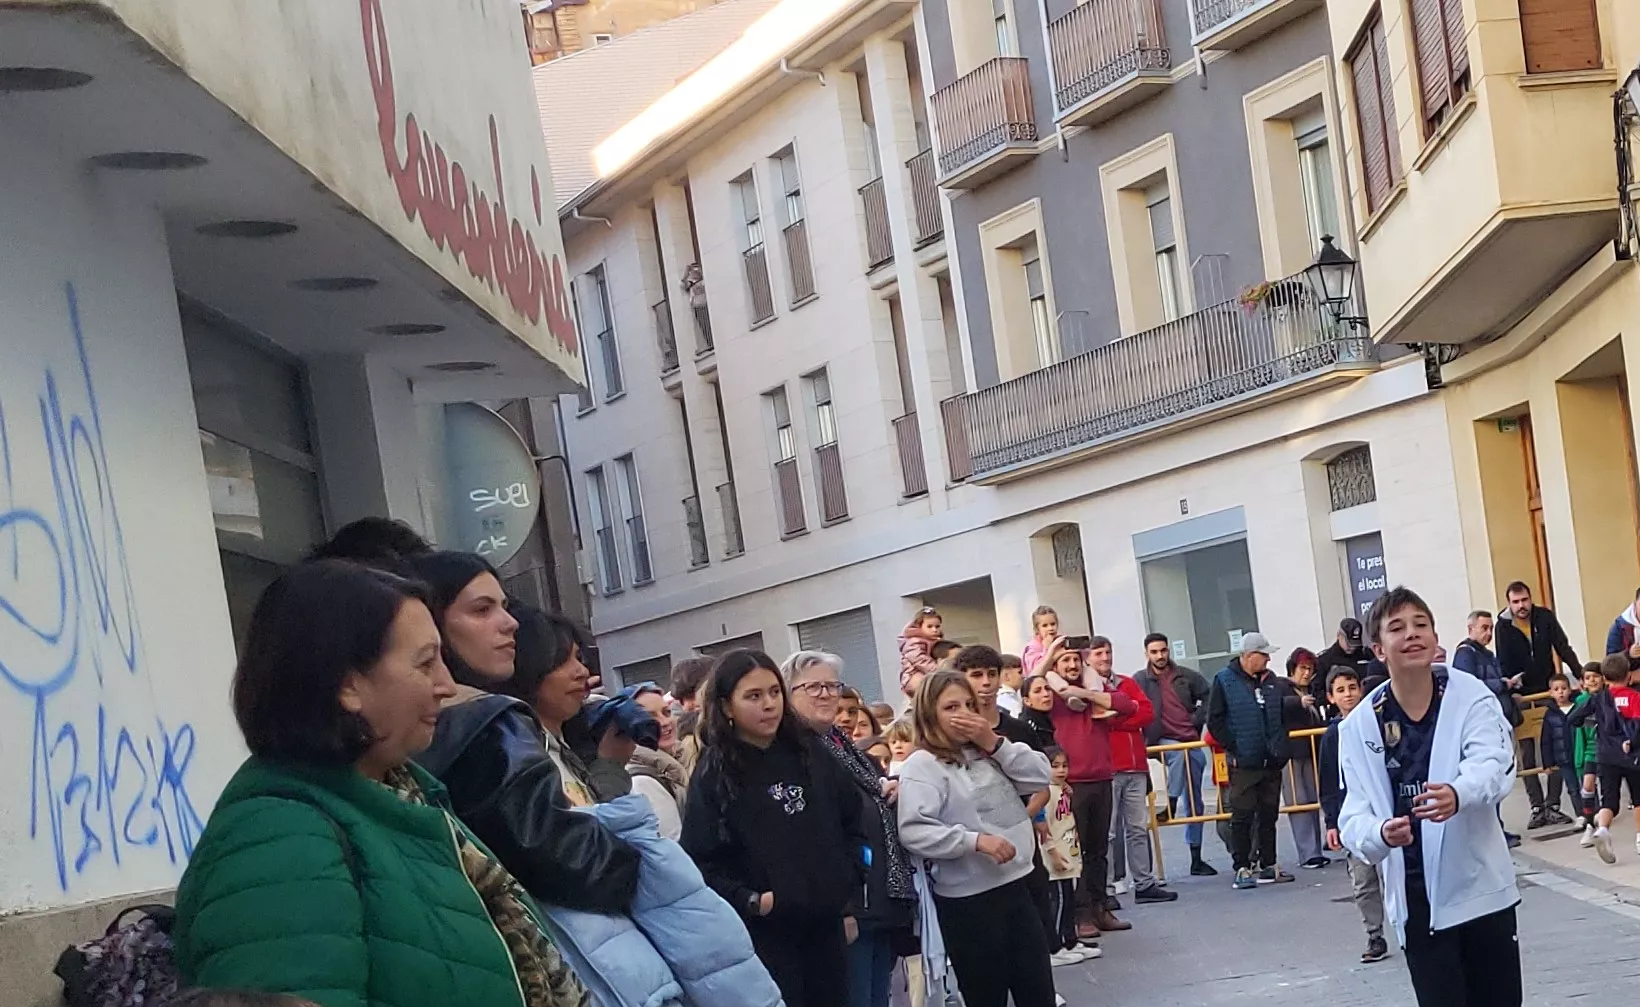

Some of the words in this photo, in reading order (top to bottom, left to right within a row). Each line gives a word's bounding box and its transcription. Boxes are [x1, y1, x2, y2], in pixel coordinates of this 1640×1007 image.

[1356, 557, 1366, 571] Te
[1358, 577, 1366, 592] el
[1366, 575, 1386, 590] local
